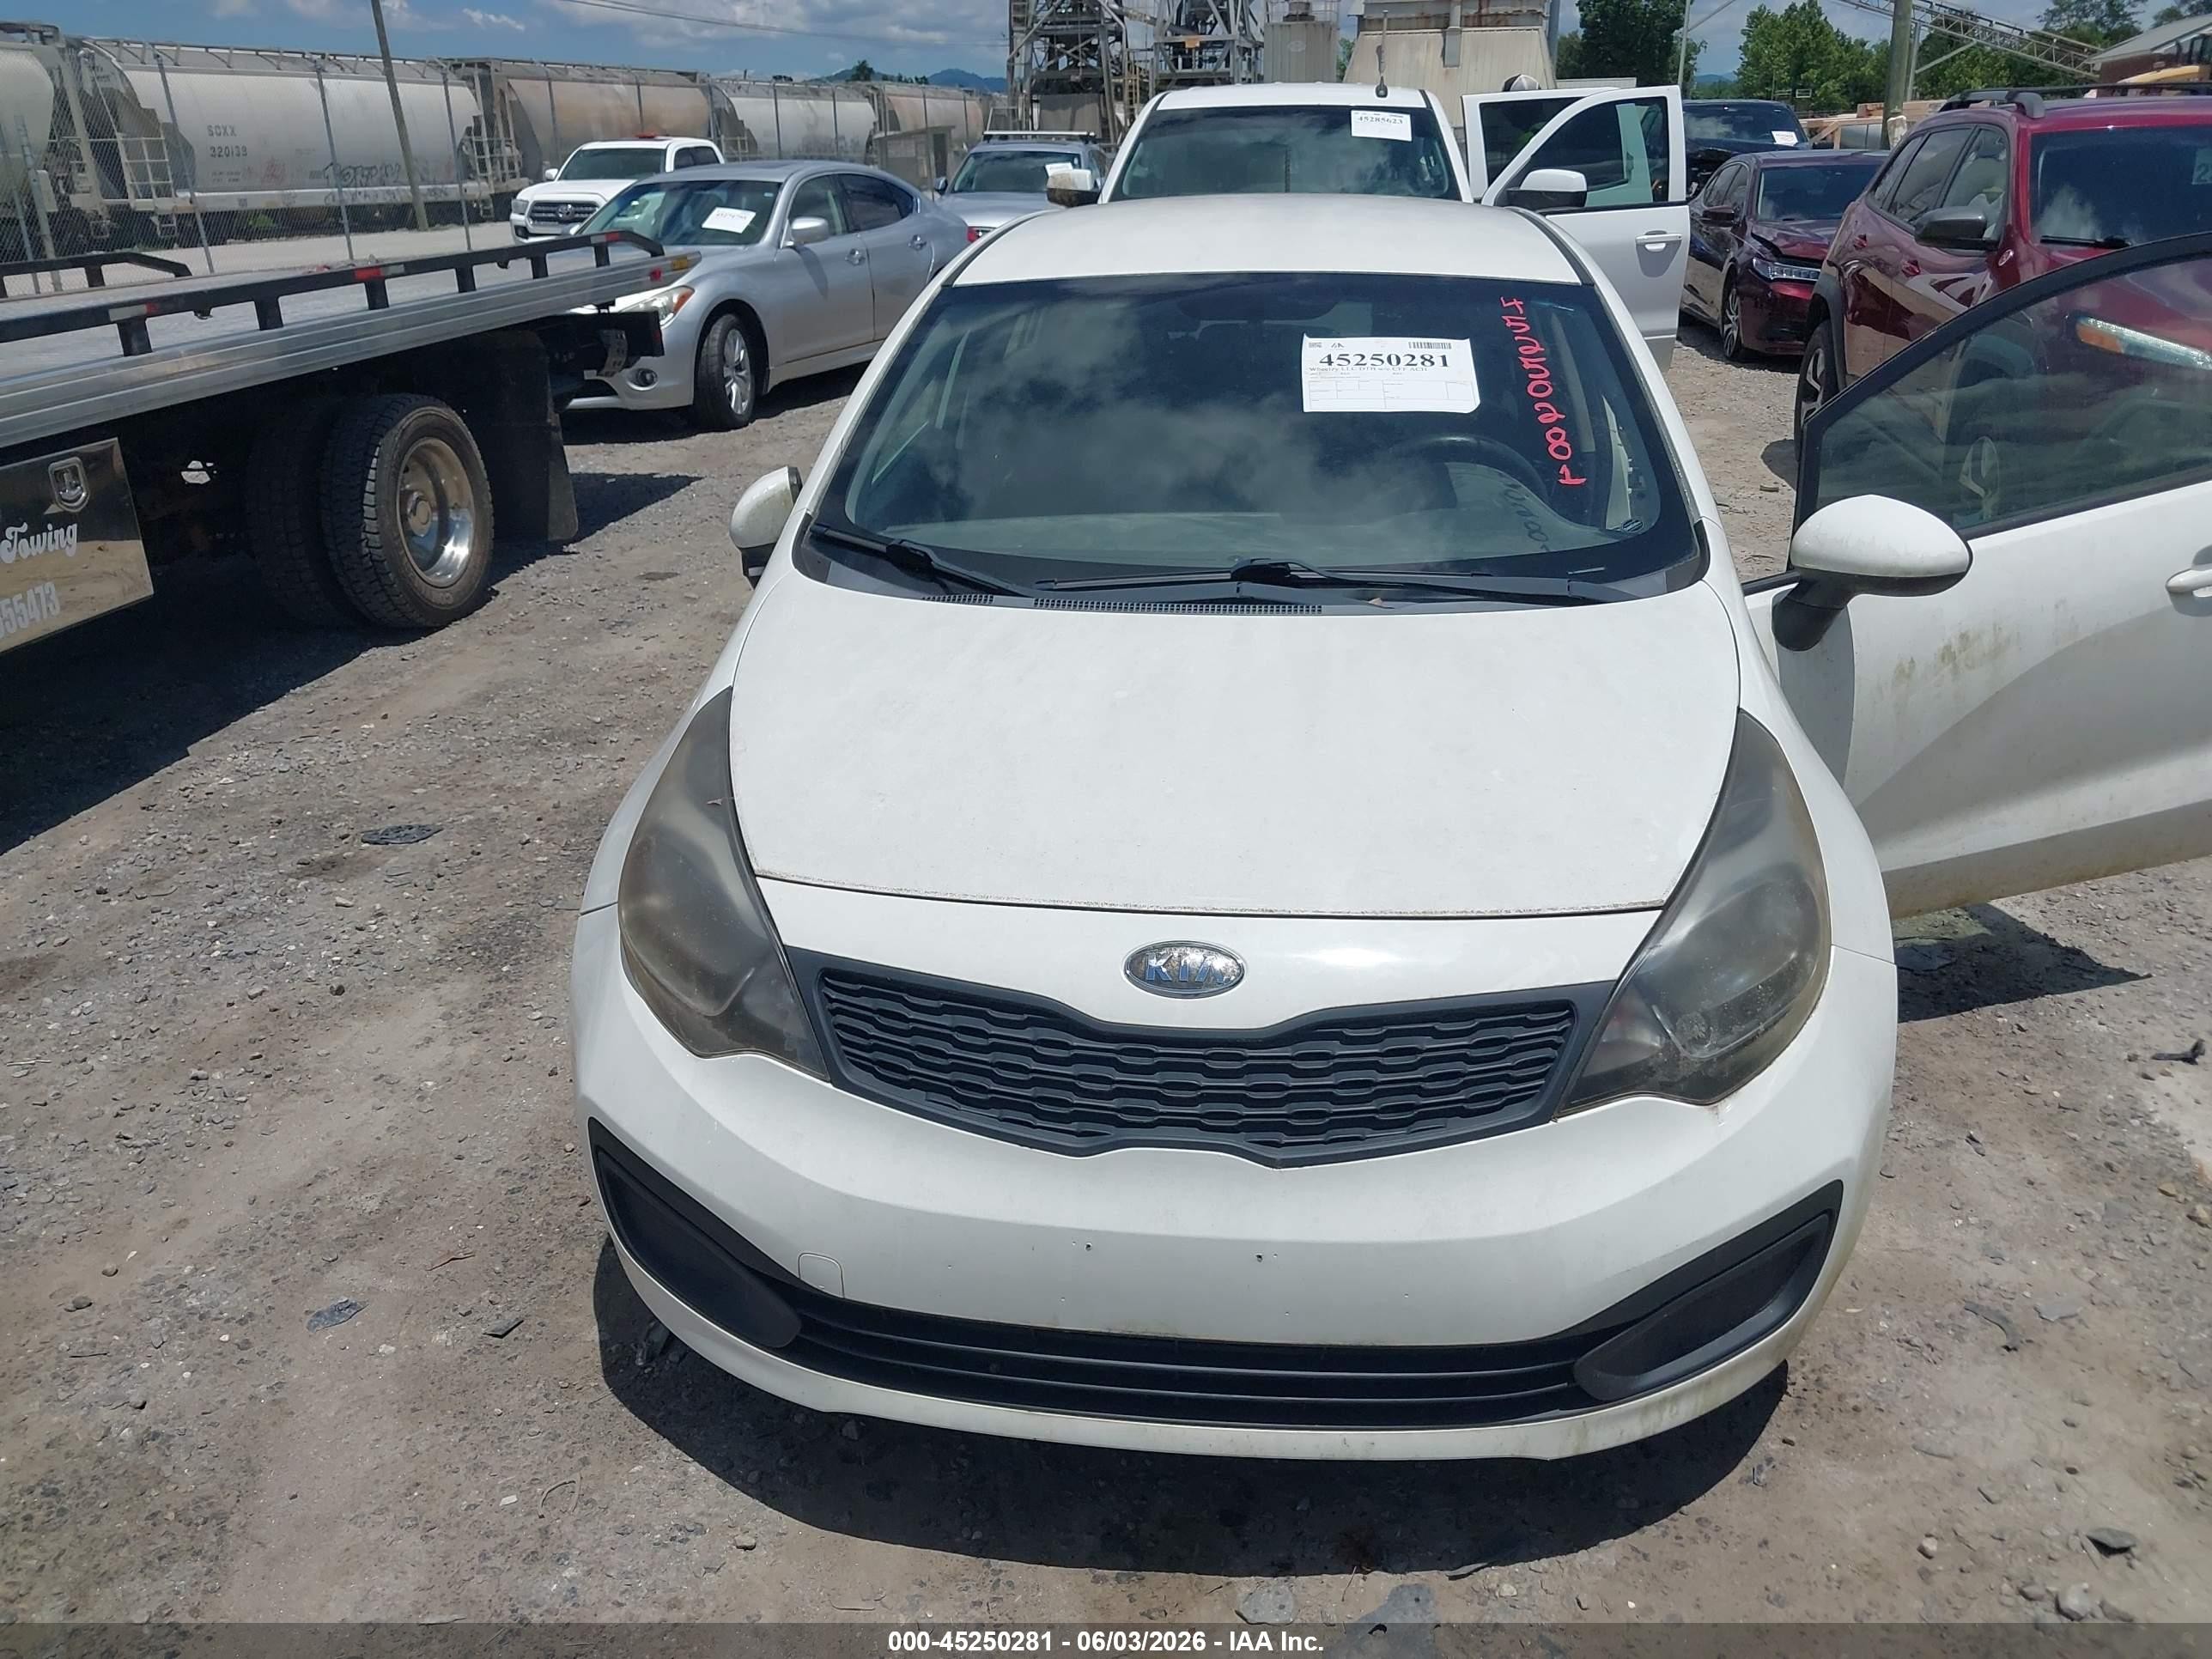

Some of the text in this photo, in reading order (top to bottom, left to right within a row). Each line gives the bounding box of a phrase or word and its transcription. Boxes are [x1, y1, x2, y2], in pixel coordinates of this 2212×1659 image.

[1319, 353, 1450, 368] 45250281
[0, 521, 78, 563] Towing
[1145, 952, 1225, 985] KIA
